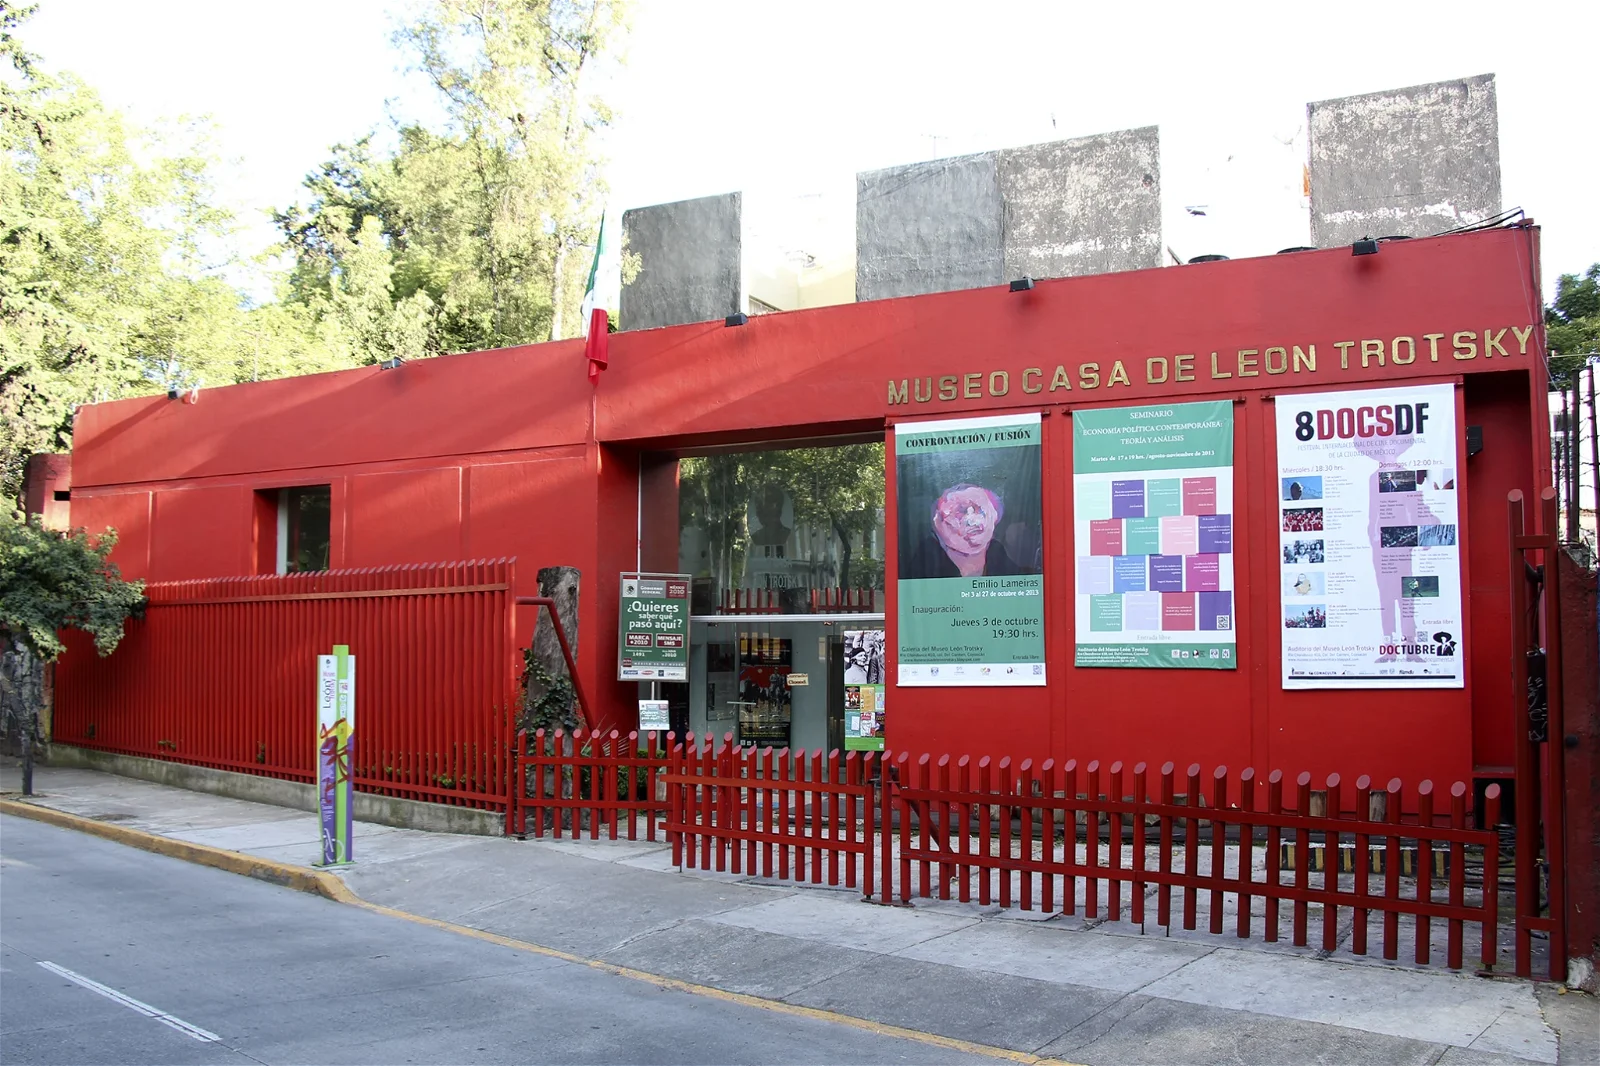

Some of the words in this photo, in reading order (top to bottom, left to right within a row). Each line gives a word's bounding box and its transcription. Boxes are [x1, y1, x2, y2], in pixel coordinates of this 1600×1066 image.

[888, 371, 1009, 405] MUSEO
[1022, 360, 1131, 394] CASA
[1146, 354, 1195, 385] DE
[1211, 344, 1316, 379] LEON
[1334, 325, 1534, 369] TROTSKY
[1130, 410, 1173, 419] SEMINARIO
[1295, 402, 1429, 442] 8DOCSDF
[1083, 426, 1121, 436] ECONOMÍA
[1122, 424, 1155, 433] POLÍTICA
[1156, 421, 1223, 432] CONTEMPORÁNEA:
[906, 433, 986, 448] CONFRONTACIÓN
[994, 428, 1031, 441] FUSIÓN
[1120, 436, 1146, 445] TEORÍA
[1152, 434, 1185, 443] ANÁLISIS
[1297, 444, 1321, 452] FESTIVAL
[1322, 441, 1365, 450] INTERNACIONAL
[1389, 437, 1426, 445] DOCUMENTAL
[1374, 448, 1395, 456] MÉXICO
[1282, 466, 1310, 474] Miércoles
[1315, 464, 1333, 472] 18:30
[1378, 461, 1407, 469] Domingos
[972, 579, 998, 588] Emilio
[1001, 578, 1039, 588] Lameiras
[627, 600, 679, 613] ¿Quieres
[912, 605, 964, 615] Inauguración:
[659, 612, 673, 620] qué
[629, 619, 652, 630] pasó
[654, 619, 683, 631] aquí?
[951, 618, 980, 627] Jueves
[982, 618, 988, 626] 3
[991, 617, 1001, 626] de
[1004, 617, 1039, 626] octubre
[992, 629, 1019, 638] 19:30
[1022, 629, 1039, 638] hrs.
[964, 645, 983, 653] Trotsky
[1355, 645, 1375, 653] Trotsky
[1379, 644, 1436, 655] DOCTUBRE
[322, 680, 331, 709] León
